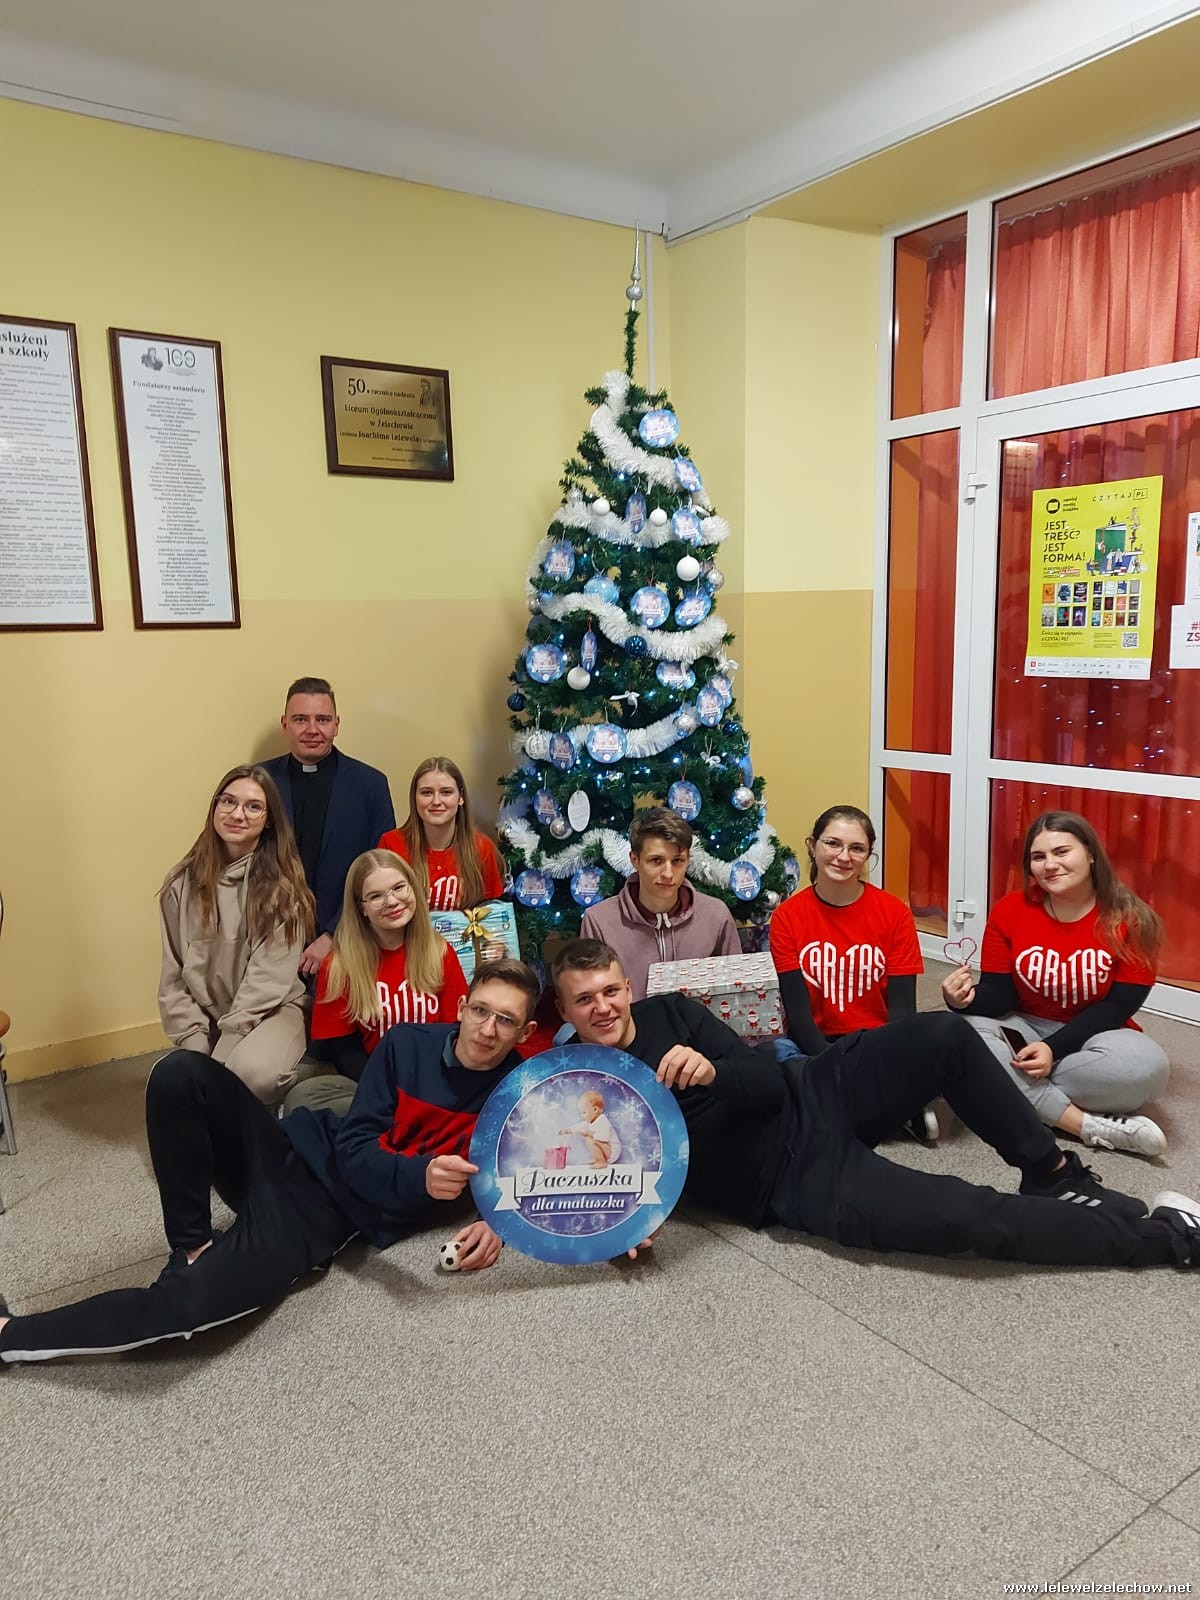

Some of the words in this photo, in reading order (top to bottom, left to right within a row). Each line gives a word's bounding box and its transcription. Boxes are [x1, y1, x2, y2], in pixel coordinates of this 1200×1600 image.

[344, 404, 369, 414] Liceum
[358, 431, 390, 441] Joachima
[391, 434, 419, 443] Lelewela
[1044, 520, 1067, 531] JEST
[1043, 542, 1066, 553] JEST
[1043, 552, 1086, 563] FORMA!
[799, 940, 887, 1012] CARITAS
[1016, 945, 1112, 1009] CARITAS
[521, 1168, 633, 1193] Paczuszka
[531, 1199, 556, 1212] dla
[557, 1195, 625, 1211] maluszka
